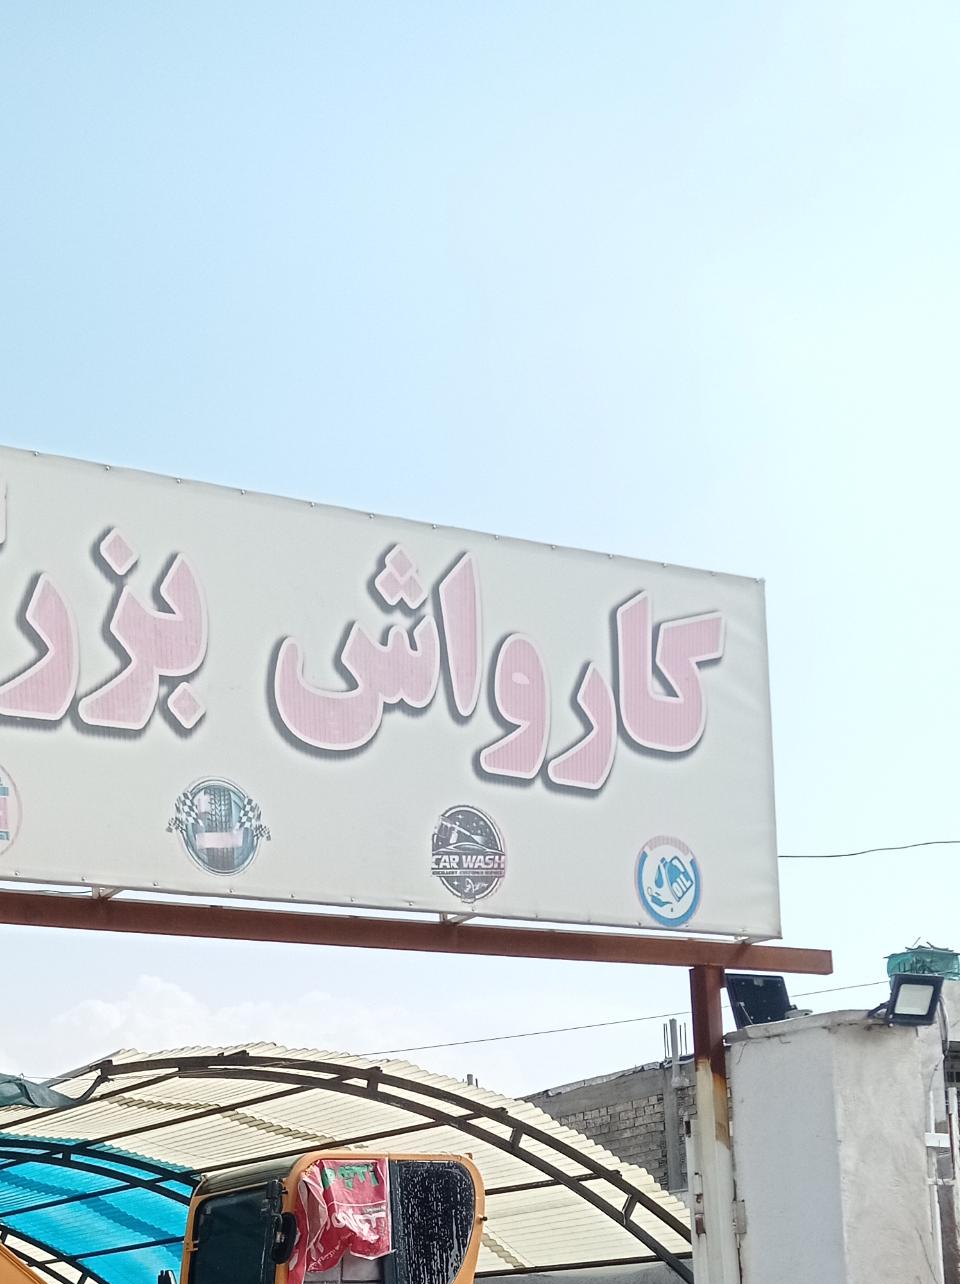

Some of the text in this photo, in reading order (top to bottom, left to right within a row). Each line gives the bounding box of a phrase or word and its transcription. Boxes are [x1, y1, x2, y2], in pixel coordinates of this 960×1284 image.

[274, 543, 727, 790] کارواش
[432, 854, 505, 869] CAR WASH
